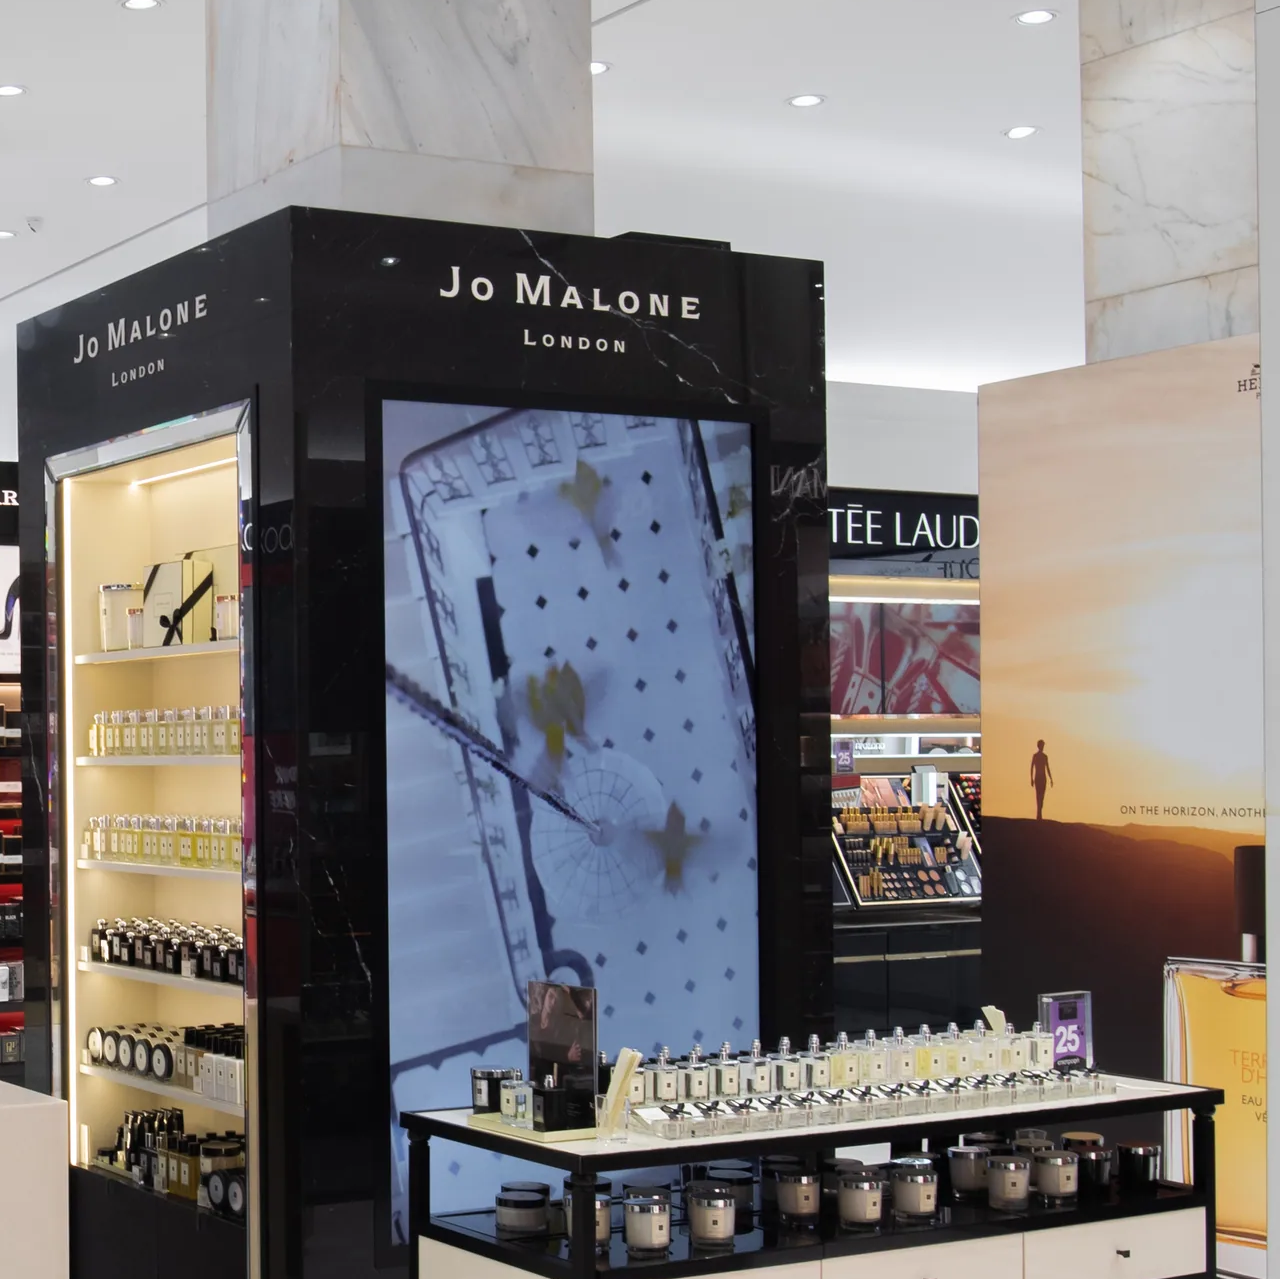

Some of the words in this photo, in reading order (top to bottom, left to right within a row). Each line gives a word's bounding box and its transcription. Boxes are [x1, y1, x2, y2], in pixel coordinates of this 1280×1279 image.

[523, 329, 626, 353] LONDON
[111, 358, 165, 387] LONDON
[895, 511, 980, 549] LAUD
[1120, 805, 1136, 815] ON
[1140, 805, 1159, 816] THE
[1163, 806, 1219, 818] HORIZON,
[1241, 1094, 1263, 1107] EAU
